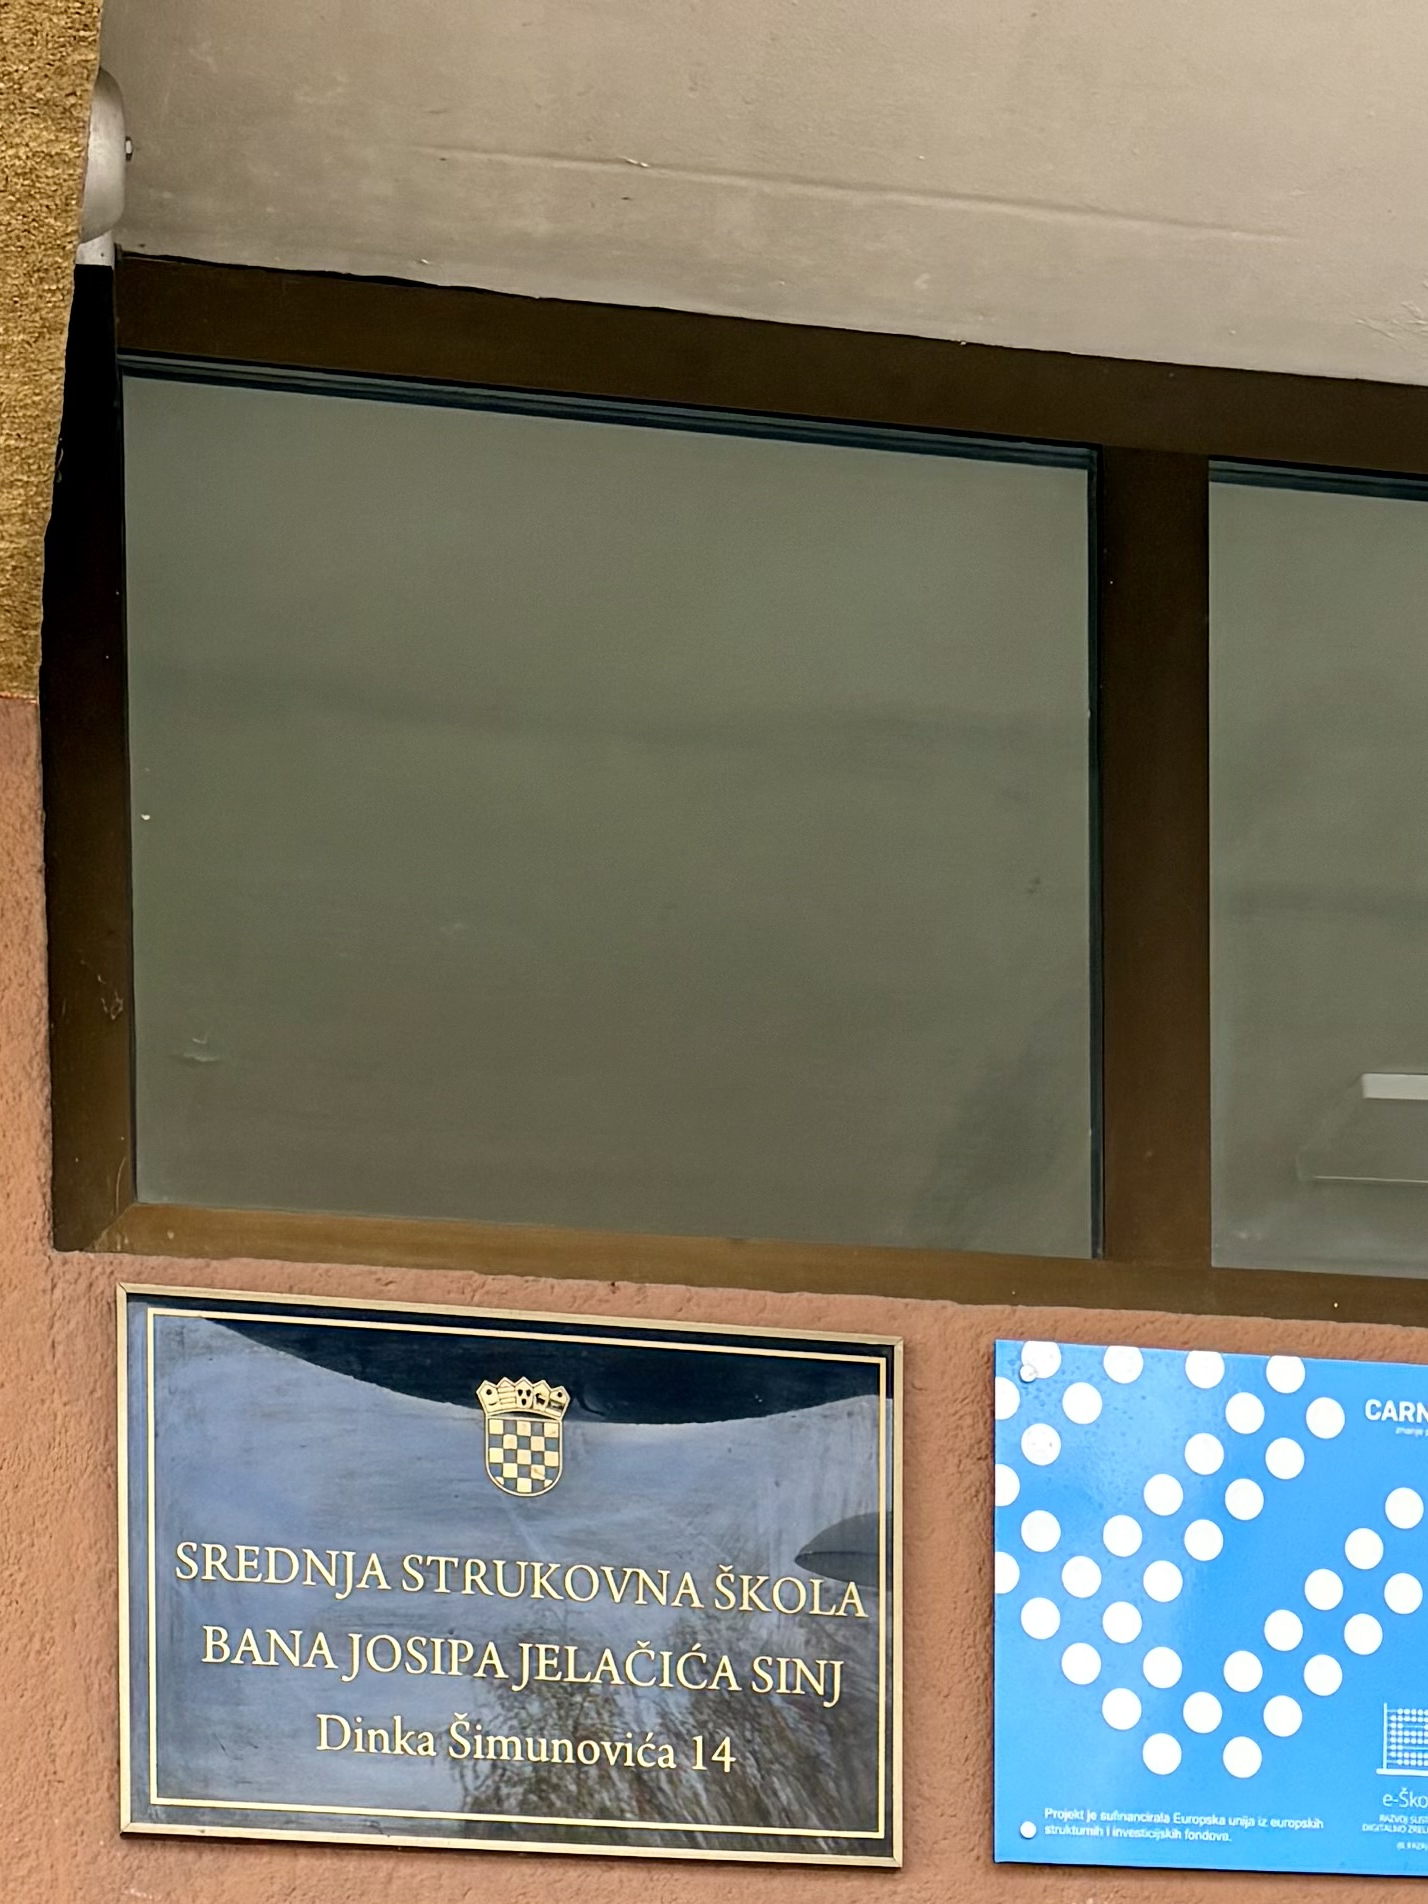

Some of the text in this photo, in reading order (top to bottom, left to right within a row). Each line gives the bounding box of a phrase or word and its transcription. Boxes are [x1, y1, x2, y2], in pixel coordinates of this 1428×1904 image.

[175, 1541, 867, 1620] SREDNJA STRUKOVNA ŠKOLA
[202, 1625, 845, 1706] BANA JOSIPA JELAČIĆA SINJ
[317, 1713, 735, 1772] Dinka Šimunovića 14
[1173, 1812, 1226, 1829] Europska
